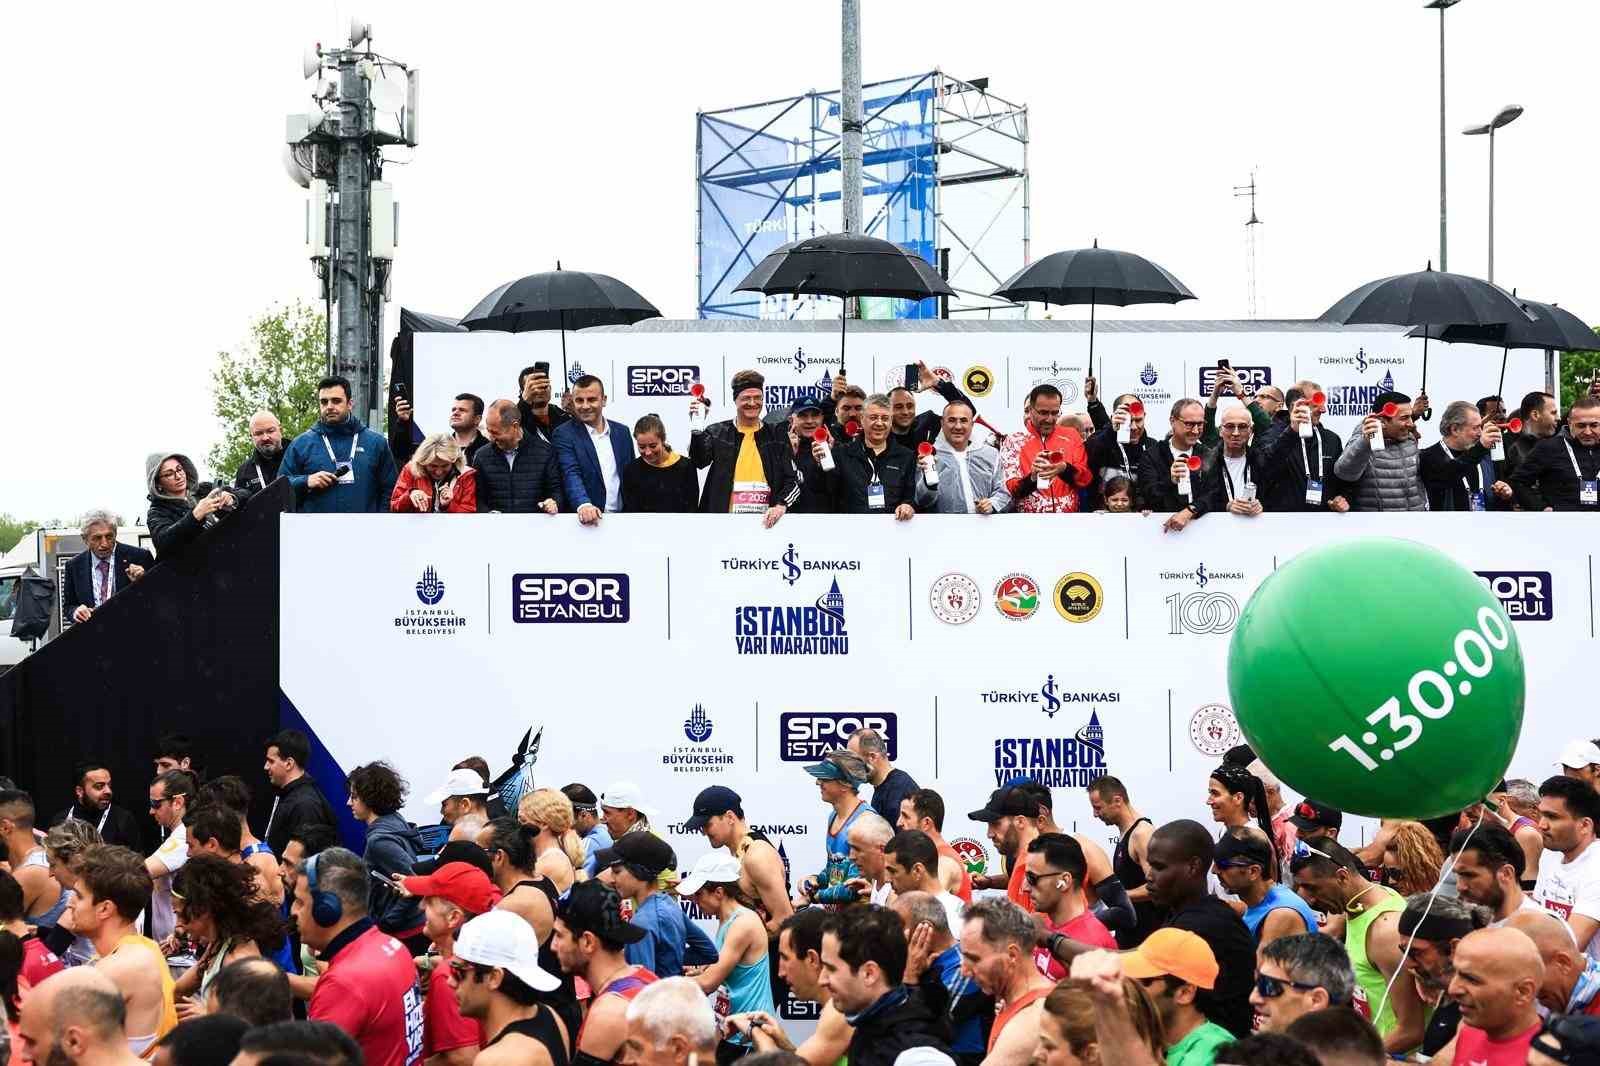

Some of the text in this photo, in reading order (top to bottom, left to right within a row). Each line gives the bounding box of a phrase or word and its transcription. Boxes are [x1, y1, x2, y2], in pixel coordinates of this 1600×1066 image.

[757, 355, 793, 364] TÜRKİYE
[1318, 356, 1355, 364] TÜRKİYE
[1368, 357, 1405, 365] BANKASI
[631, 368, 696, 383] SPOR
[1203, 369, 1267, 384] SOR
[631, 383, 692, 394] İSTANBU
[1327, 404, 1347, 416] YARI
[721, 557, 779, 570] TÜRKİYE
[803, 560, 861, 571] BANKASI
[1160, 571, 1195, 579] TÜRKİYE
[519, 578, 622, 601] SPOR
[1480, 576, 1545, 599] OR
[394, 616, 467, 628] BÜYÜKŞEHİR
[735, 637, 849, 655] YARI MARATONU
[1328, 606, 1509, 771] 1:30:00
[980, 690, 1039, 703] TÜRKİYE
[1062, 692, 1121, 703] BANKASI
[787, 717, 891, 740] SPOR
[663, 754, 734, 765] BÜYÜKŞEHİR
